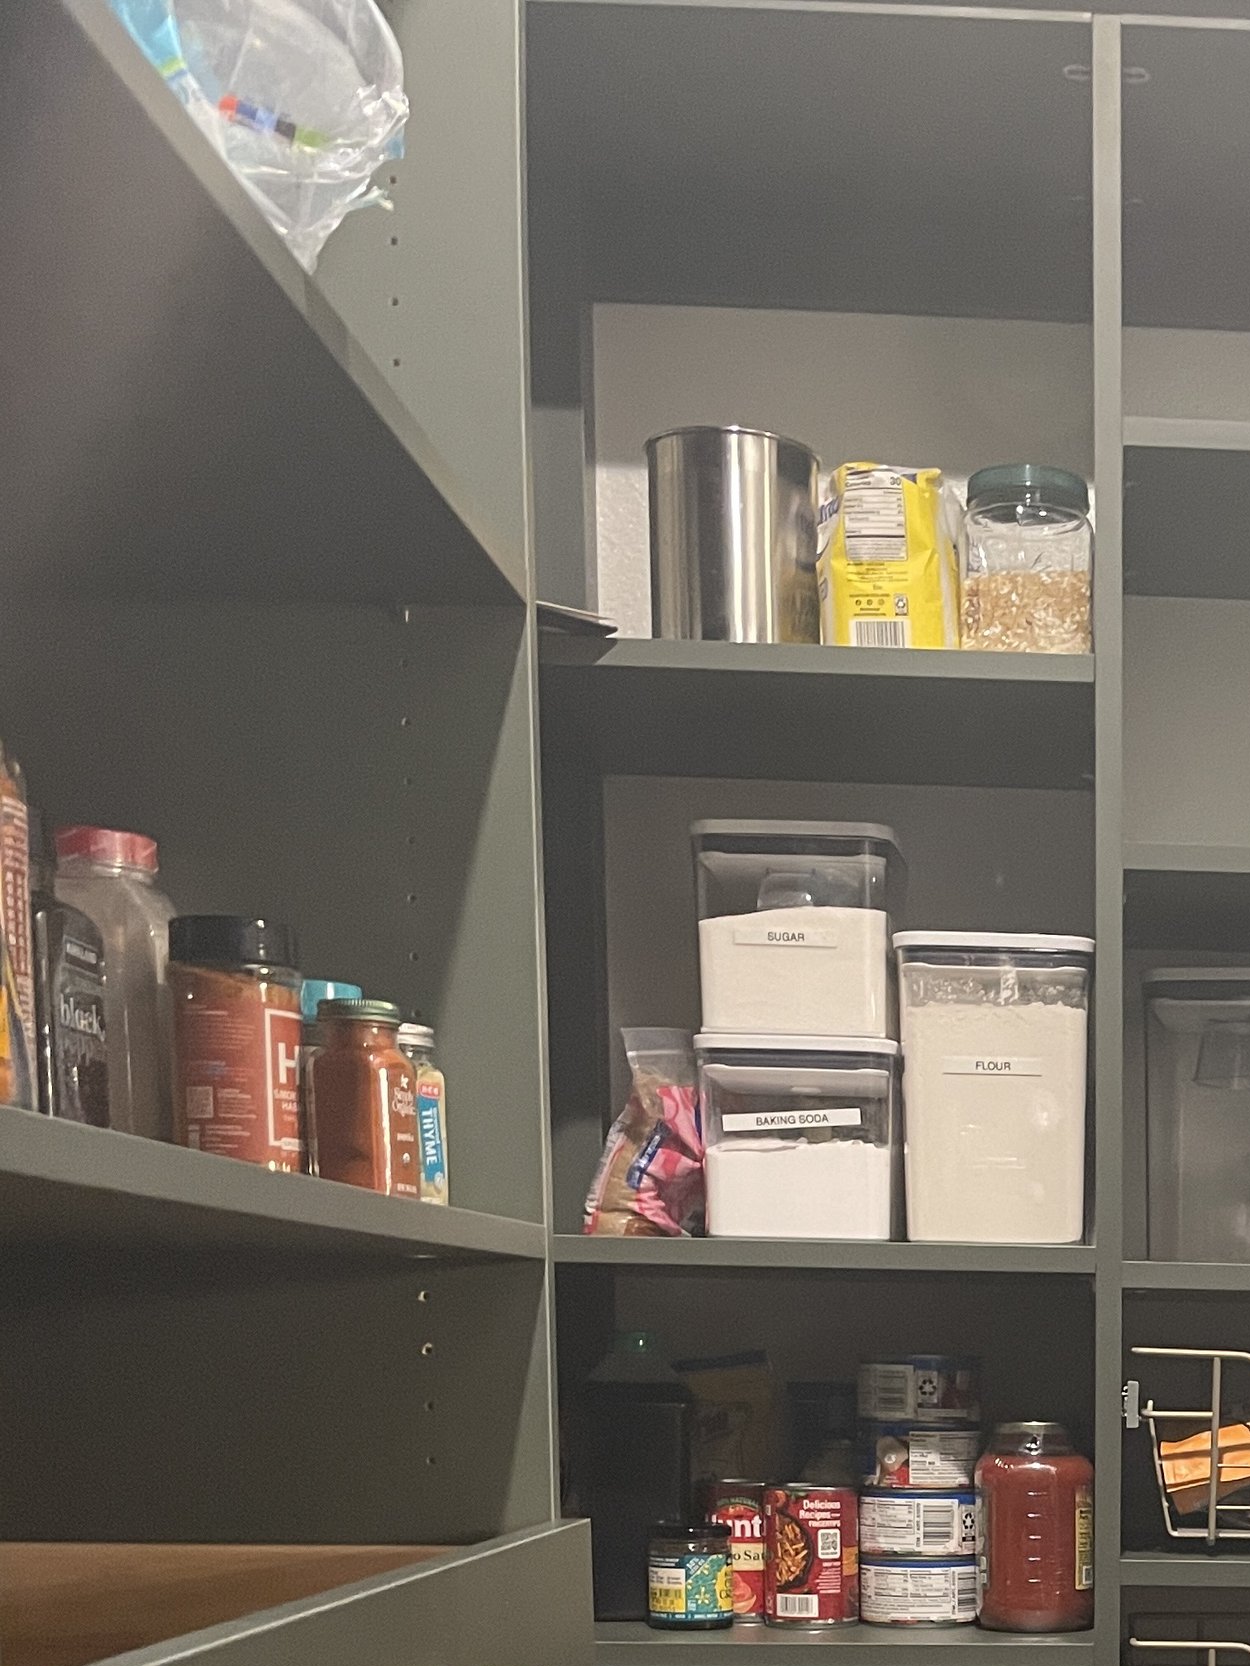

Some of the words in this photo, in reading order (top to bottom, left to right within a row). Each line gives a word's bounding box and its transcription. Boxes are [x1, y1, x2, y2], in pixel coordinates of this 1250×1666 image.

[767, 931, 805, 942] SUGAR
[975, 1060, 1011, 1071] FLOUR
[756, 1115, 796, 1127] BAKING
[799, 1113, 829, 1125] SODA
[421, 1107, 438, 1166] THYME
[803, 1500, 841, 1509] Delicious
